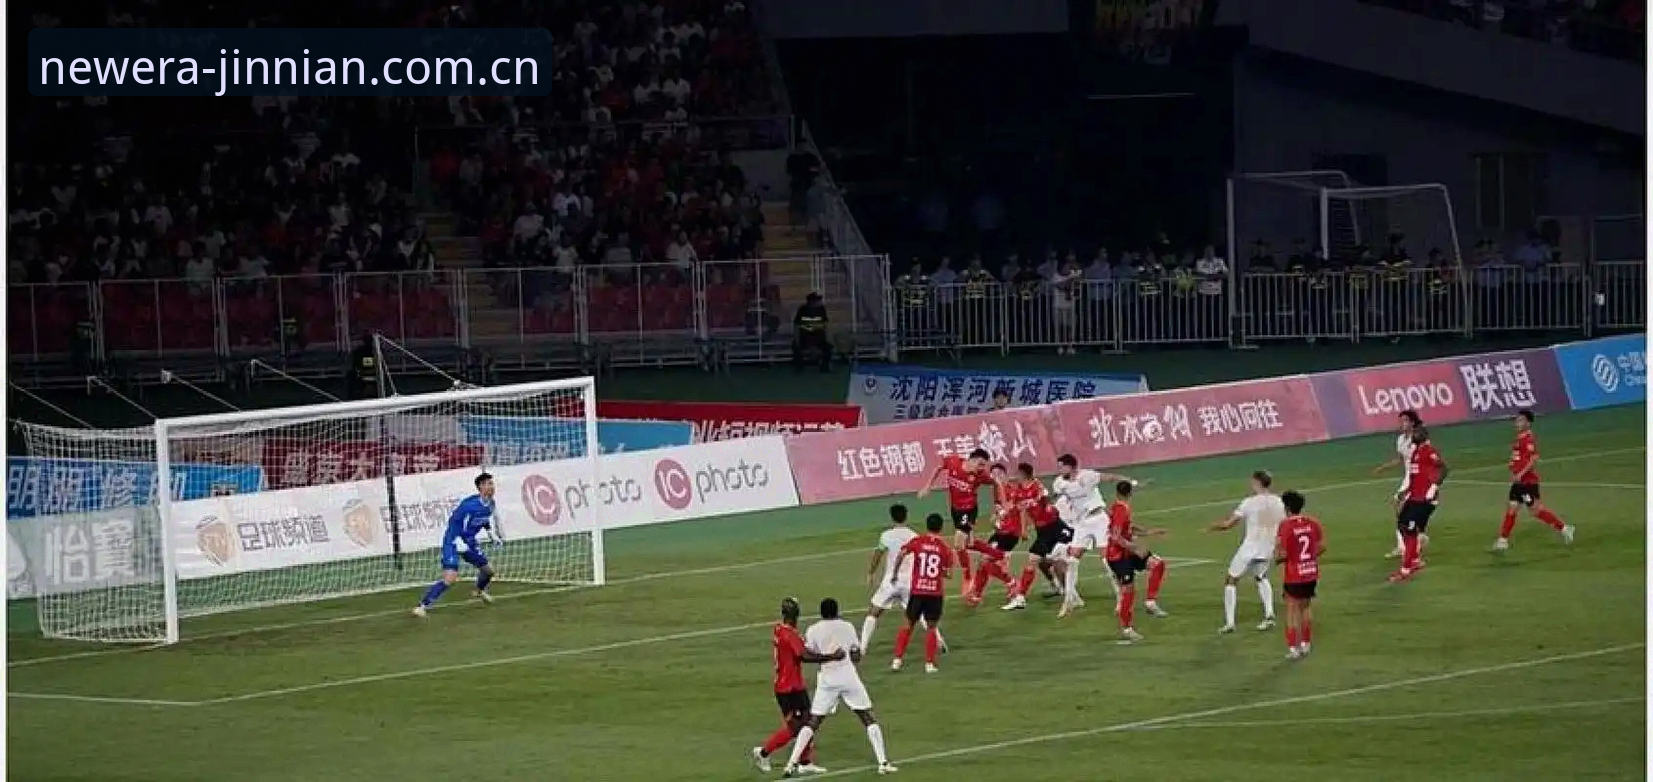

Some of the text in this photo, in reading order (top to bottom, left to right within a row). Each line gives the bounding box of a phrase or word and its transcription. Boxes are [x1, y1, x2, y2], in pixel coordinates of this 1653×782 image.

[1359, 381, 1453, 415] Lenovo
[1460, 359, 1537, 412] 联想
[1197, 399, 1284, 436] 我心向往
[837, 441, 926, 481] 红色钢都
[695, 458, 770, 504] photo
[237, 514, 332, 552] 足球频道
[1298, 535, 1312, 561] 2
[918, 552, 941, 579] 18
